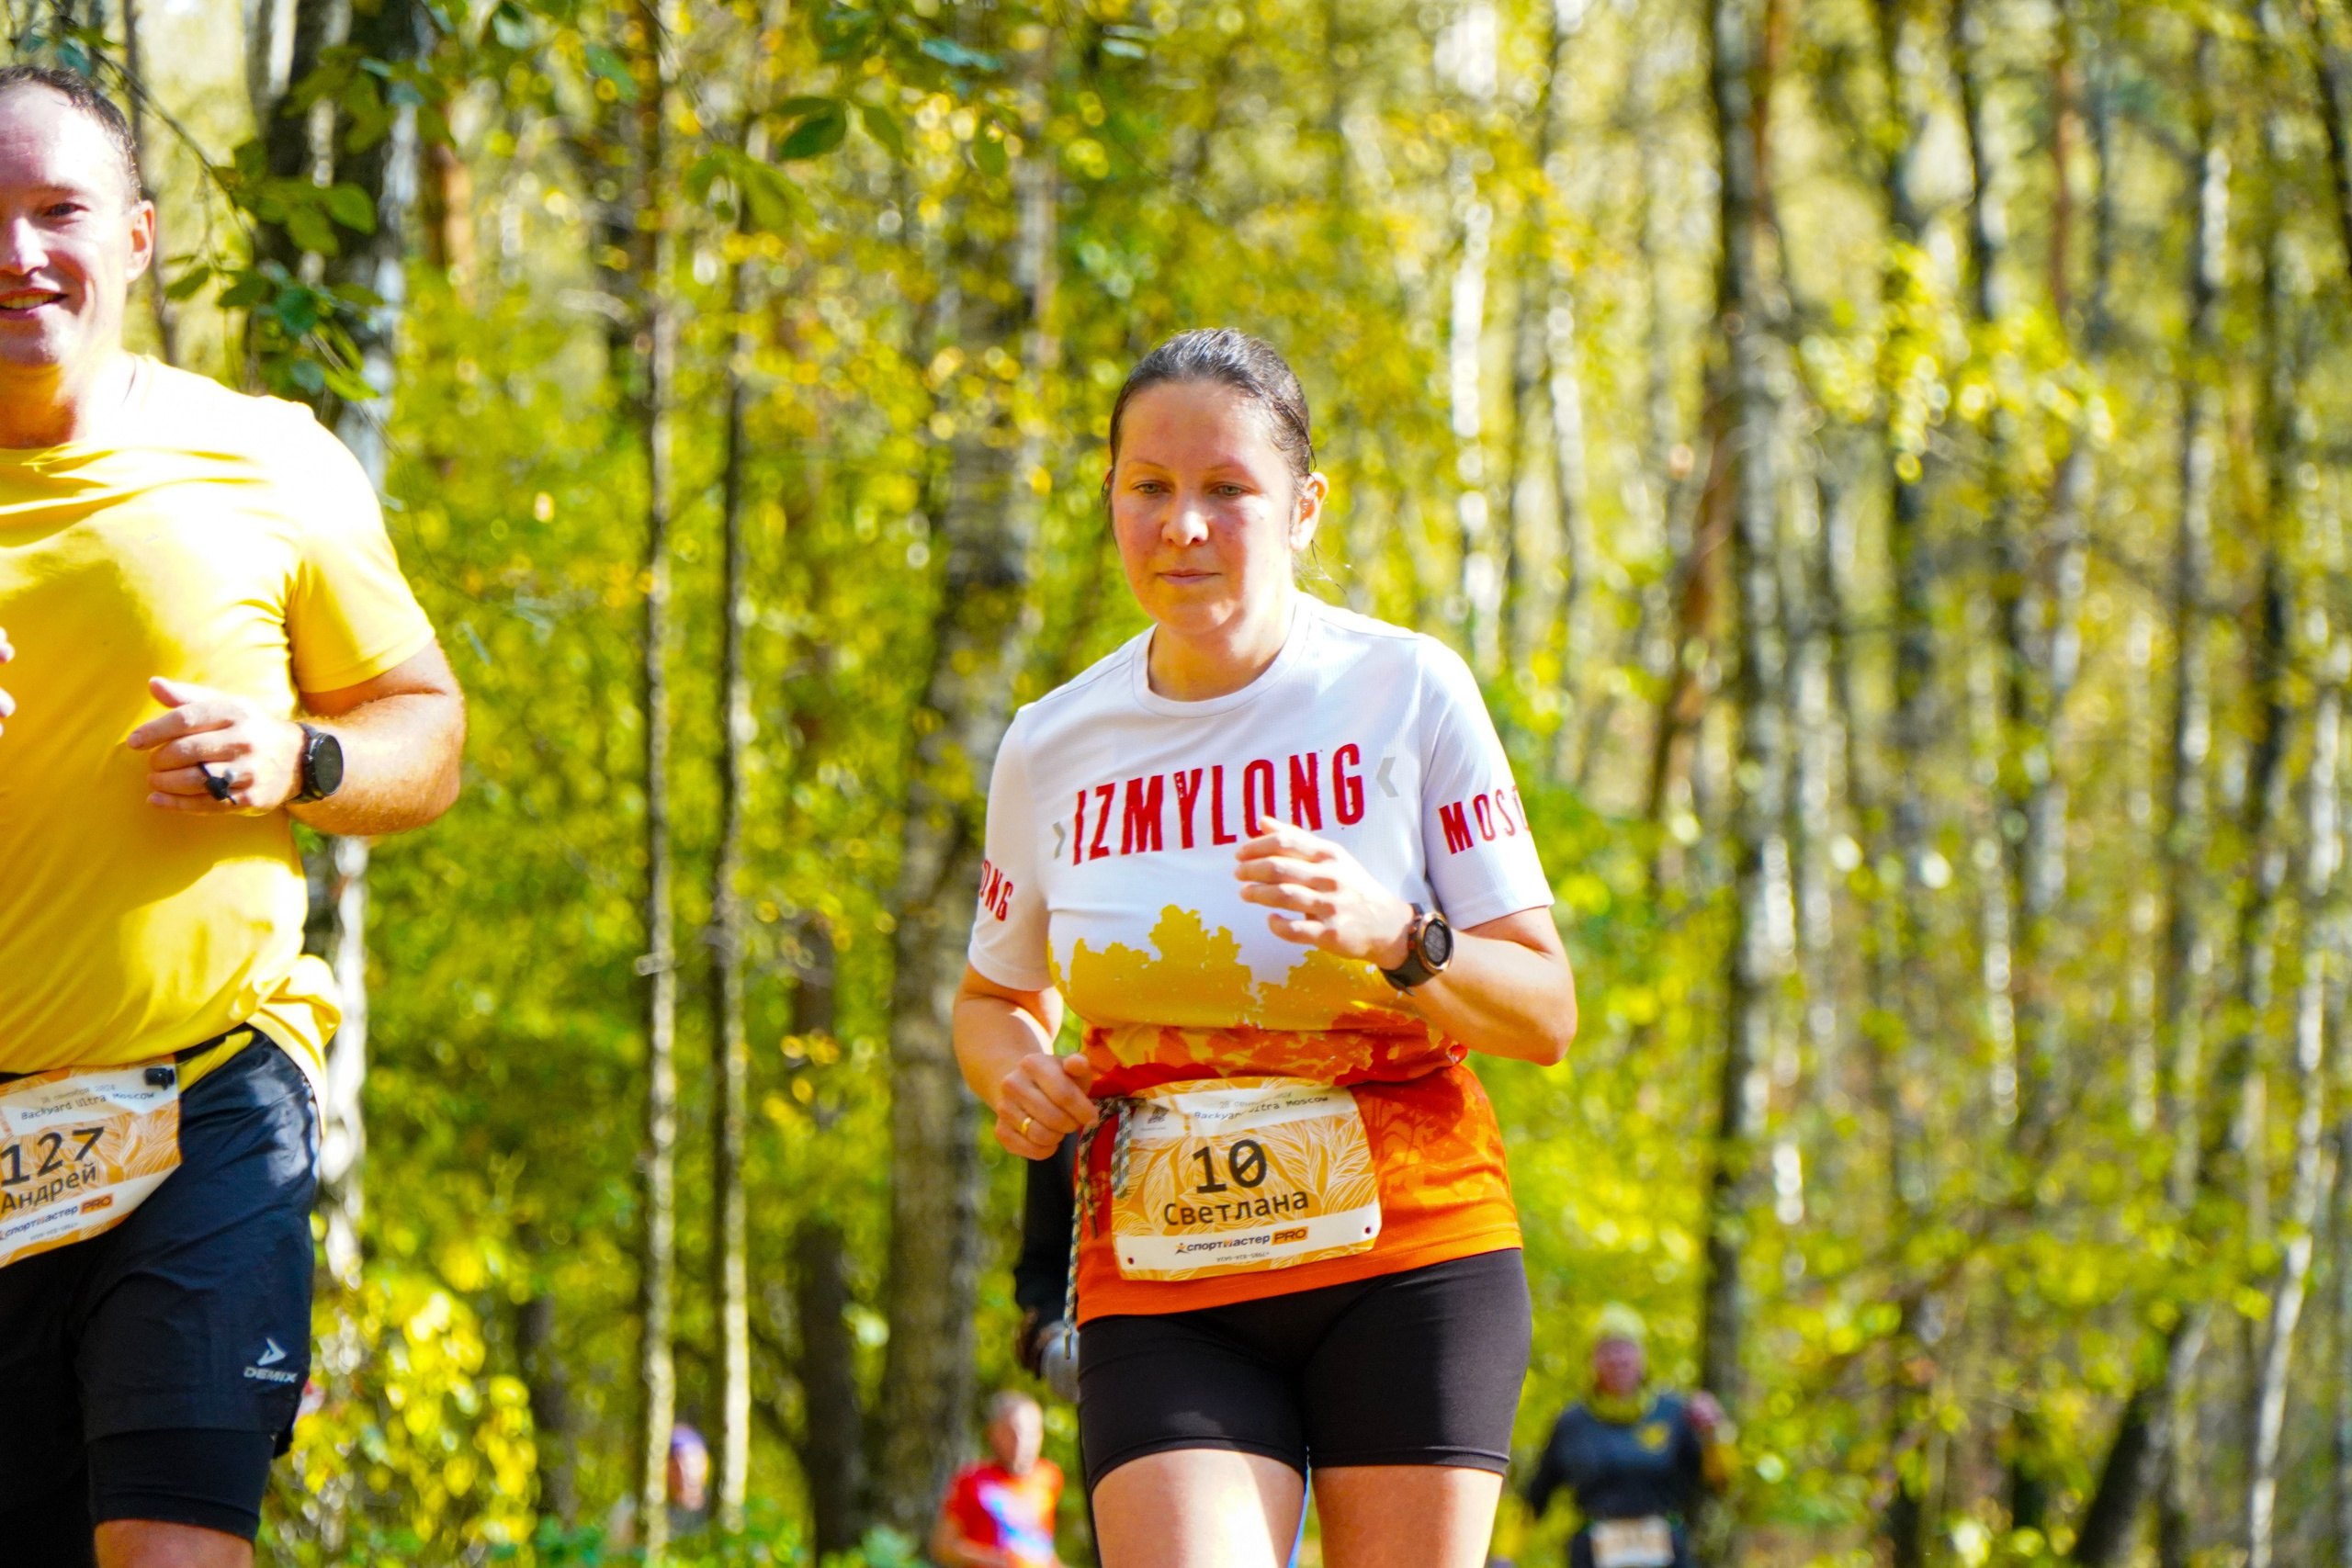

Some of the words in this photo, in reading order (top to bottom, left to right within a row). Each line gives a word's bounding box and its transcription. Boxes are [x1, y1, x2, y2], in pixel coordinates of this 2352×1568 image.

[1072, 742, 1365, 866] IZMYLONG
[21, 1102, 73, 1121] Backyard
[75, 1094, 107, 1109] Ultra
[112, 1091, 155, 1100] Moscow
[1194, 1109, 1247, 1121] Backyar
[1286, 1095, 1329, 1108] Moscow
[0, 1126, 105, 1187] 127
[1192, 1139, 1268, 1194] 10
[1, 1162, 96, 1215] Андрей
[81, 1196, 111, 1213] PRO
[1163, 1190, 1309, 1227] Светлана
[1273, 1228, 1306, 1244] PRO
[243, 1366, 298, 1383] DEMIX
